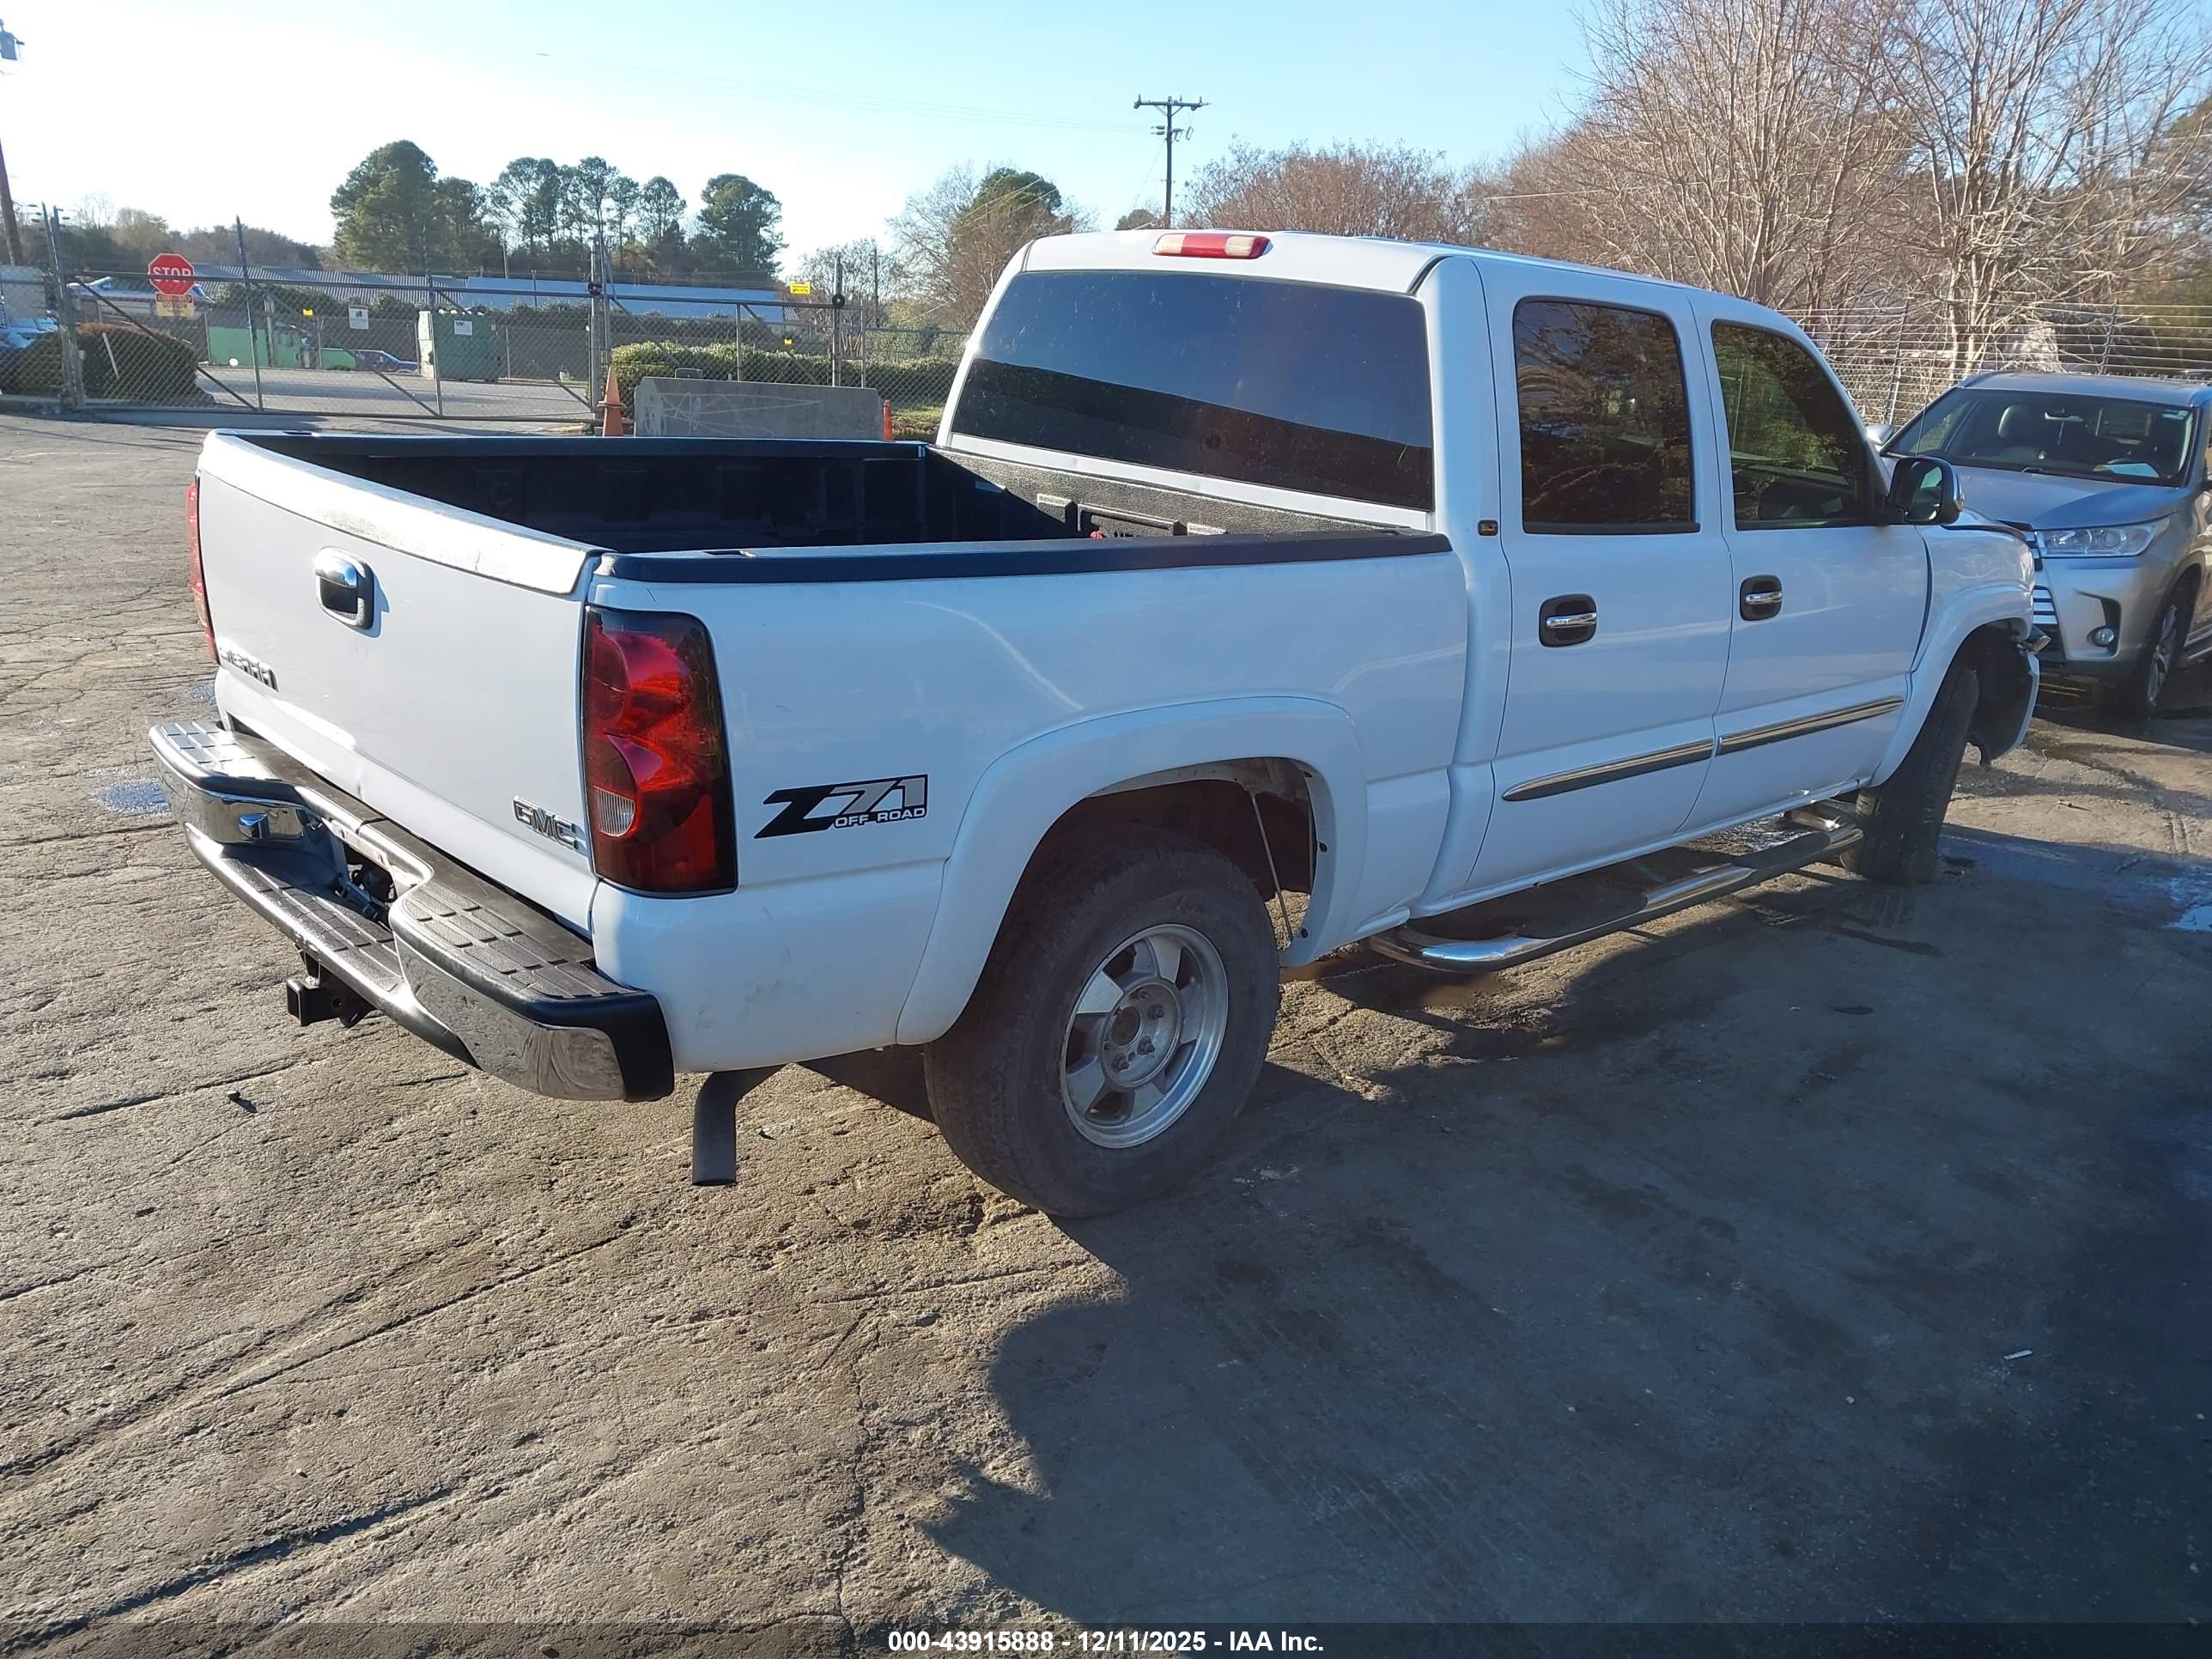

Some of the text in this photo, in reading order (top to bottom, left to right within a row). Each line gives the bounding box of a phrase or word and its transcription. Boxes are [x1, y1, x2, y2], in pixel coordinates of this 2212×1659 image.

[152, 266, 191, 283] STOP
[513, 795, 579, 851] GMC
[754, 774, 928, 839] Z71
[834, 806, 927, 828] OFF ROAD
